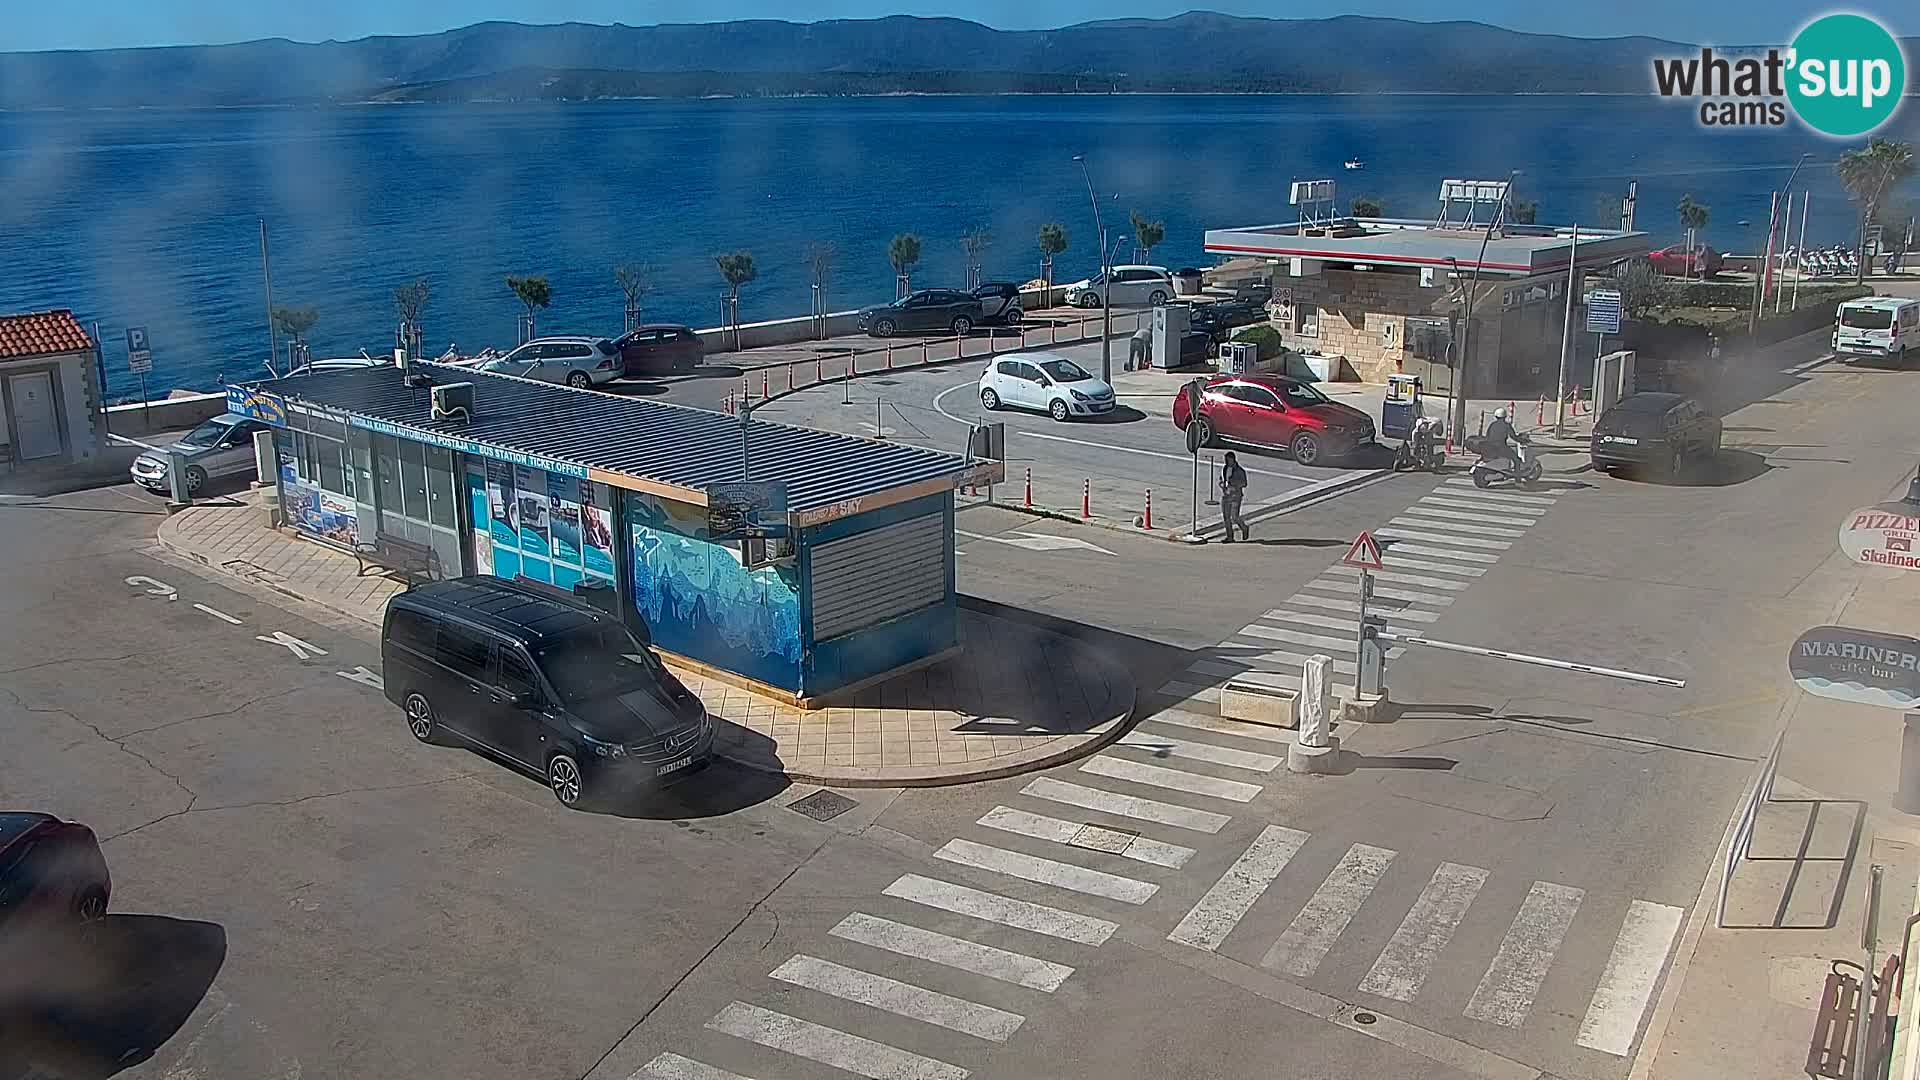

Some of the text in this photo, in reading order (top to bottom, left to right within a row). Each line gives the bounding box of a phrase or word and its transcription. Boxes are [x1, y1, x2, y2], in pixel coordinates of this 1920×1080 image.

[131, 330, 144, 348] P
[373, 421, 397, 435] KARATA
[397, 426, 437, 443] AUTOBUSNA
[437, 434, 469, 451] POSTAJA
[479, 445, 494, 456] BUS
[494, 448, 527, 464] STATION
[528, 456, 555, 470] TICKET
[556, 462, 583, 476] OFFICE
[1849, 514, 1920, 532] PIZZE
[1882, 530, 1918, 540] GRILL
[1871, 665, 1897, 679] bar
